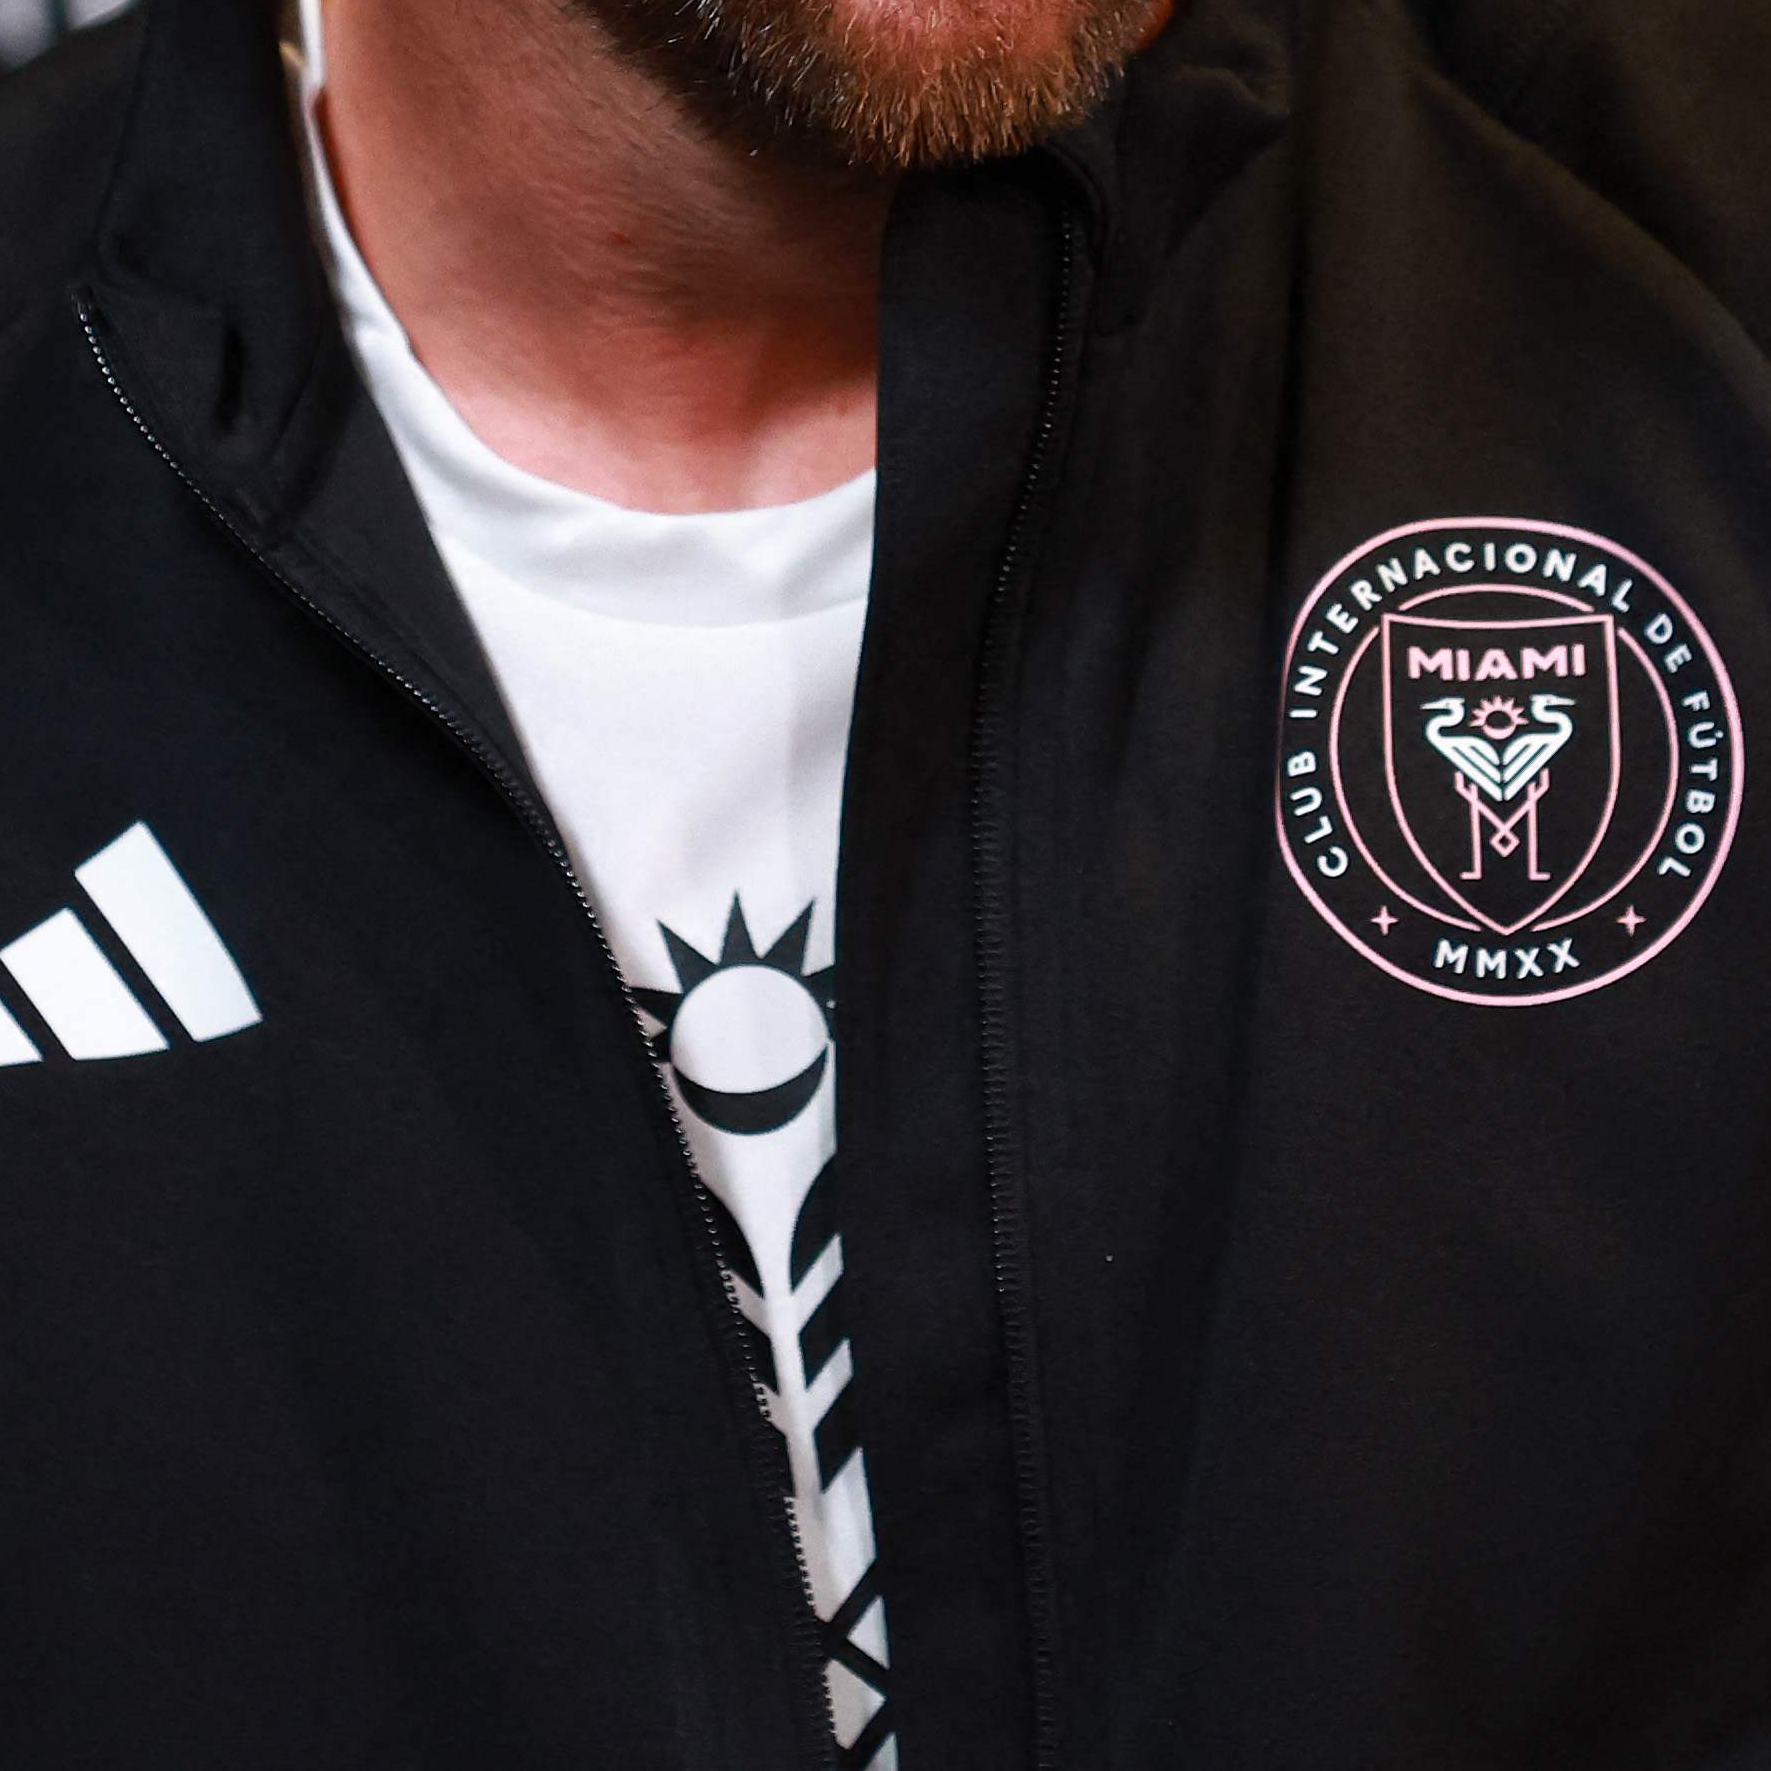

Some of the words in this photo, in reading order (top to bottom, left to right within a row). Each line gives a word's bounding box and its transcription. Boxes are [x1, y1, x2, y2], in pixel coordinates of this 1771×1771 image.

[1288, 541, 1633, 719] INTERNACIONAL
[1406, 643, 1587, 682] MIAMI
[1643, 612, 1693, 675] DE
[1286, 749, 1349, 878] CLUB
[1657, 690, 1724, 878] FÚTBOL
[1433, 938, 1581, 981] MMXX
